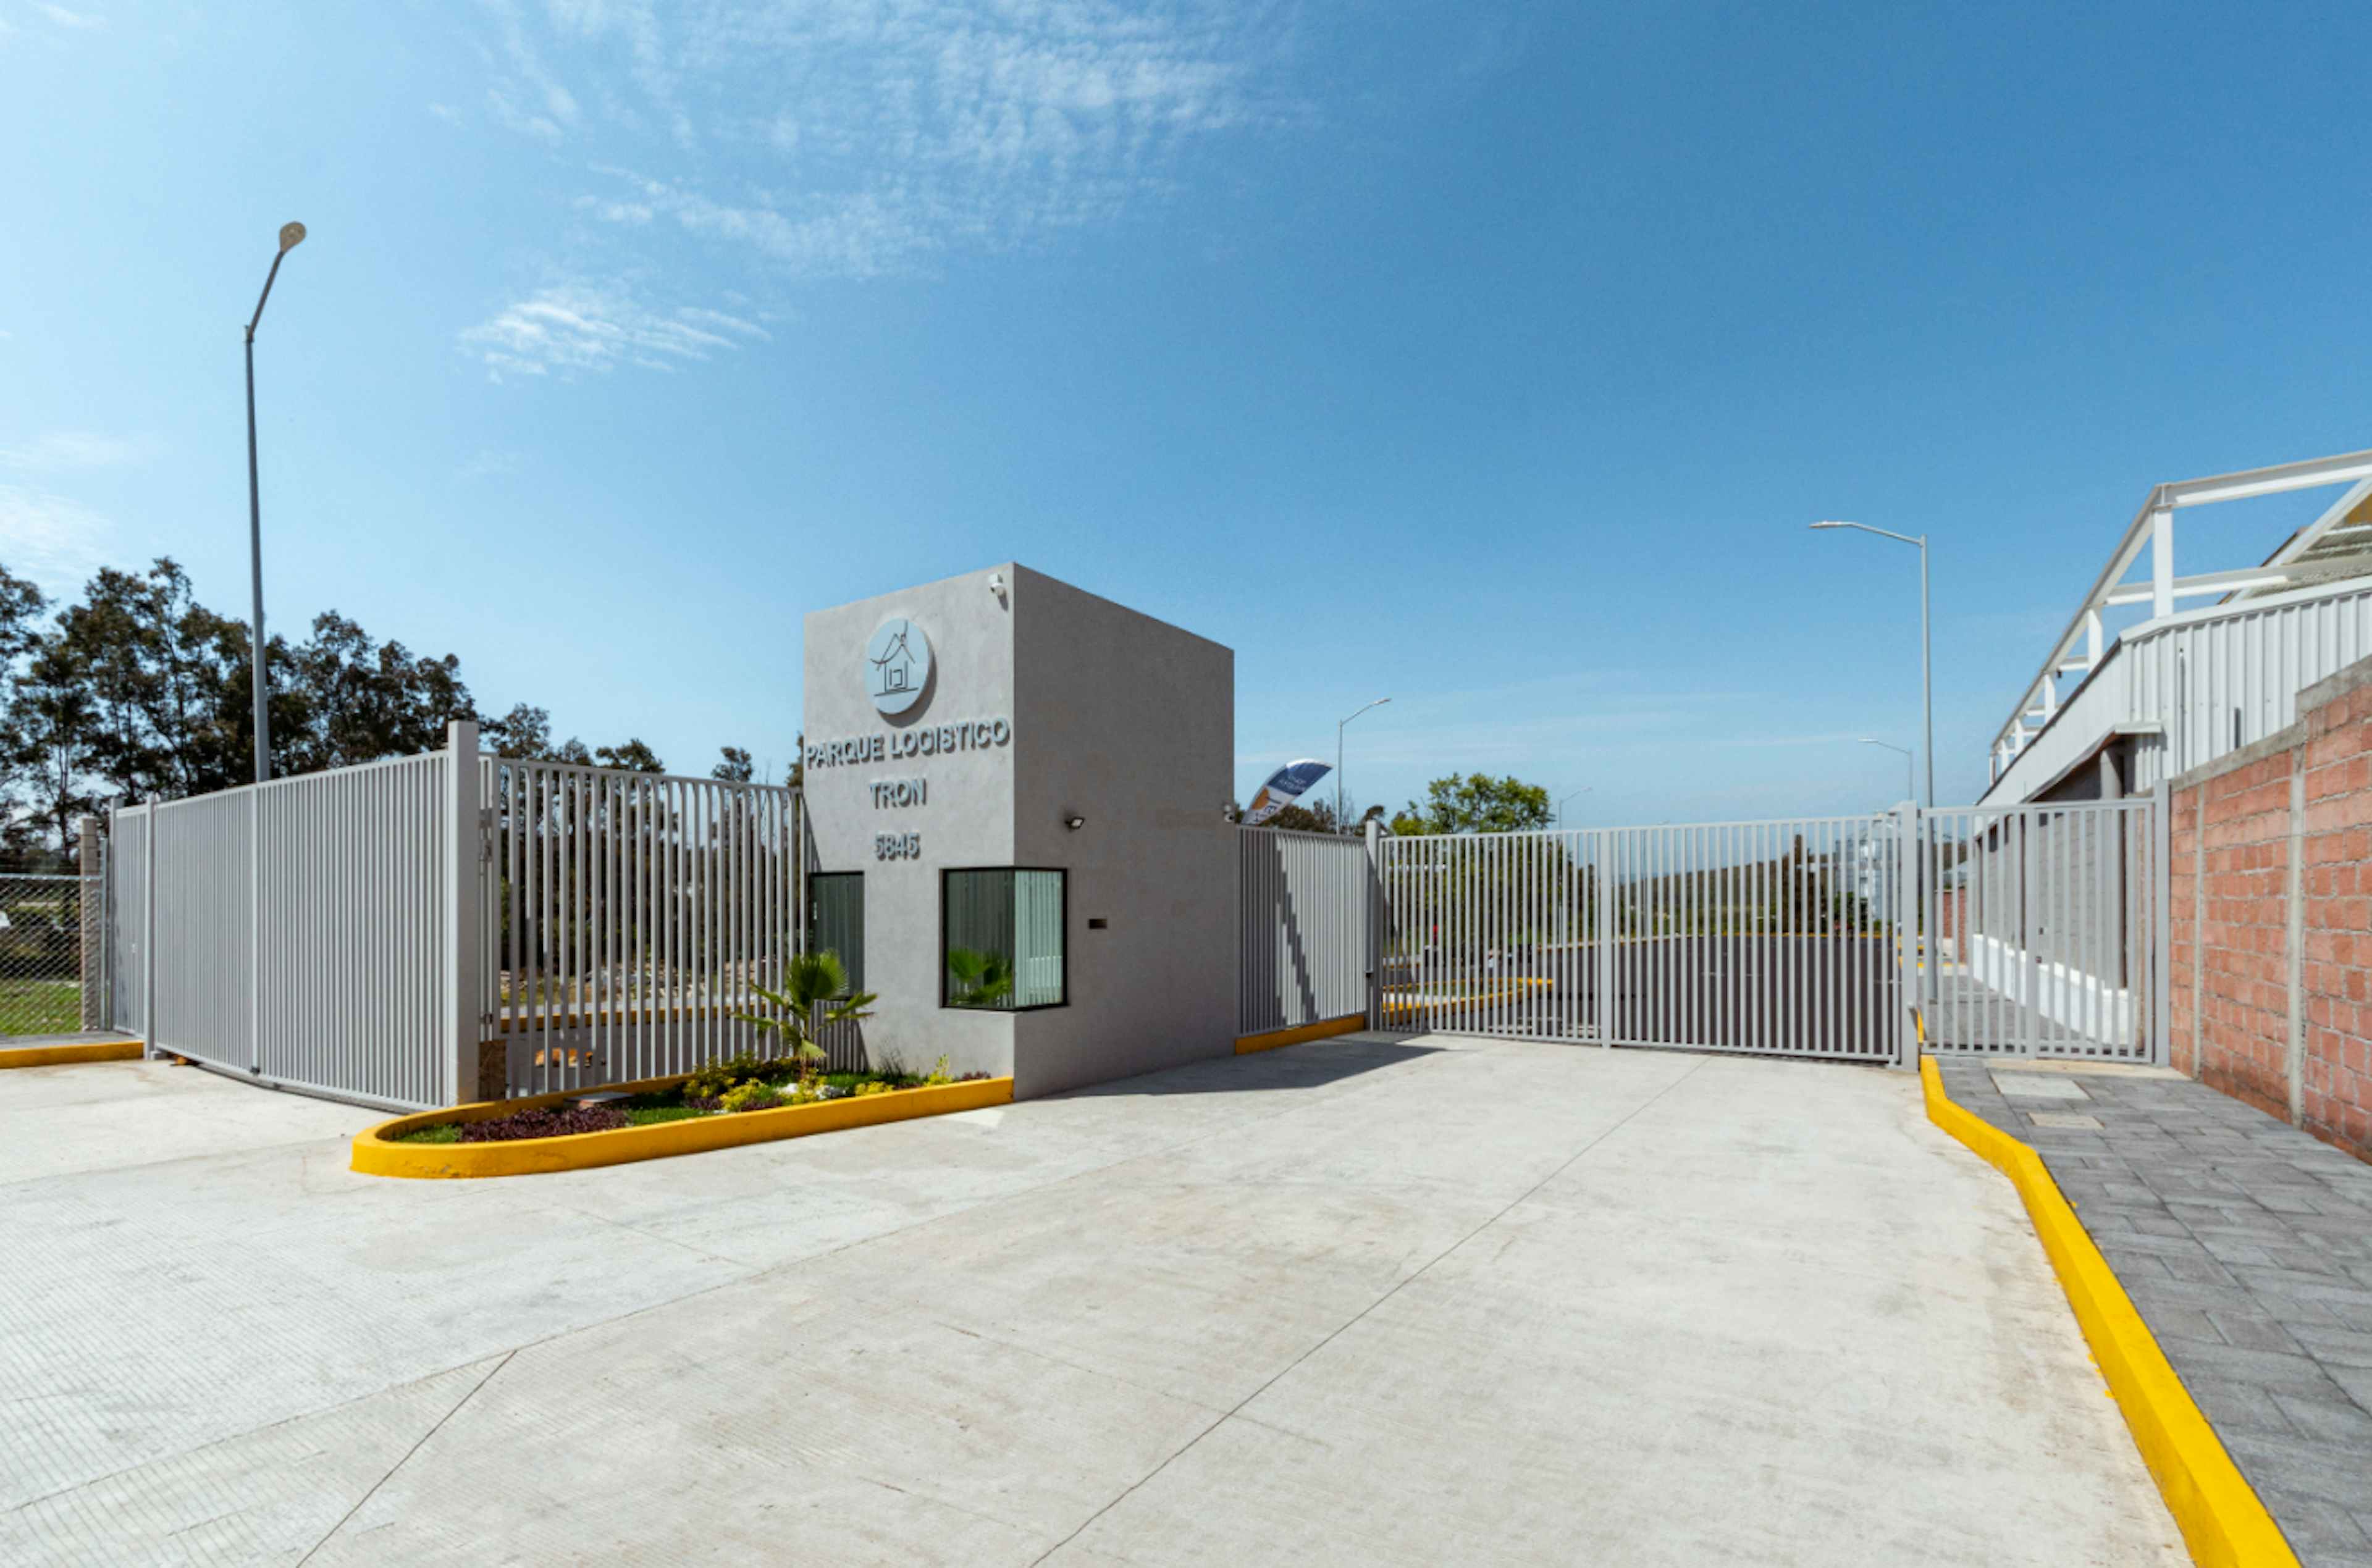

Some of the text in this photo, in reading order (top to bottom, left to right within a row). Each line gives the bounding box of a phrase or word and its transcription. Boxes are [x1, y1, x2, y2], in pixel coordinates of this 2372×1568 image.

[806, 718, 1010, 768] PARQUE LOGISTICO
[870, 779, 927, 808] TRON
